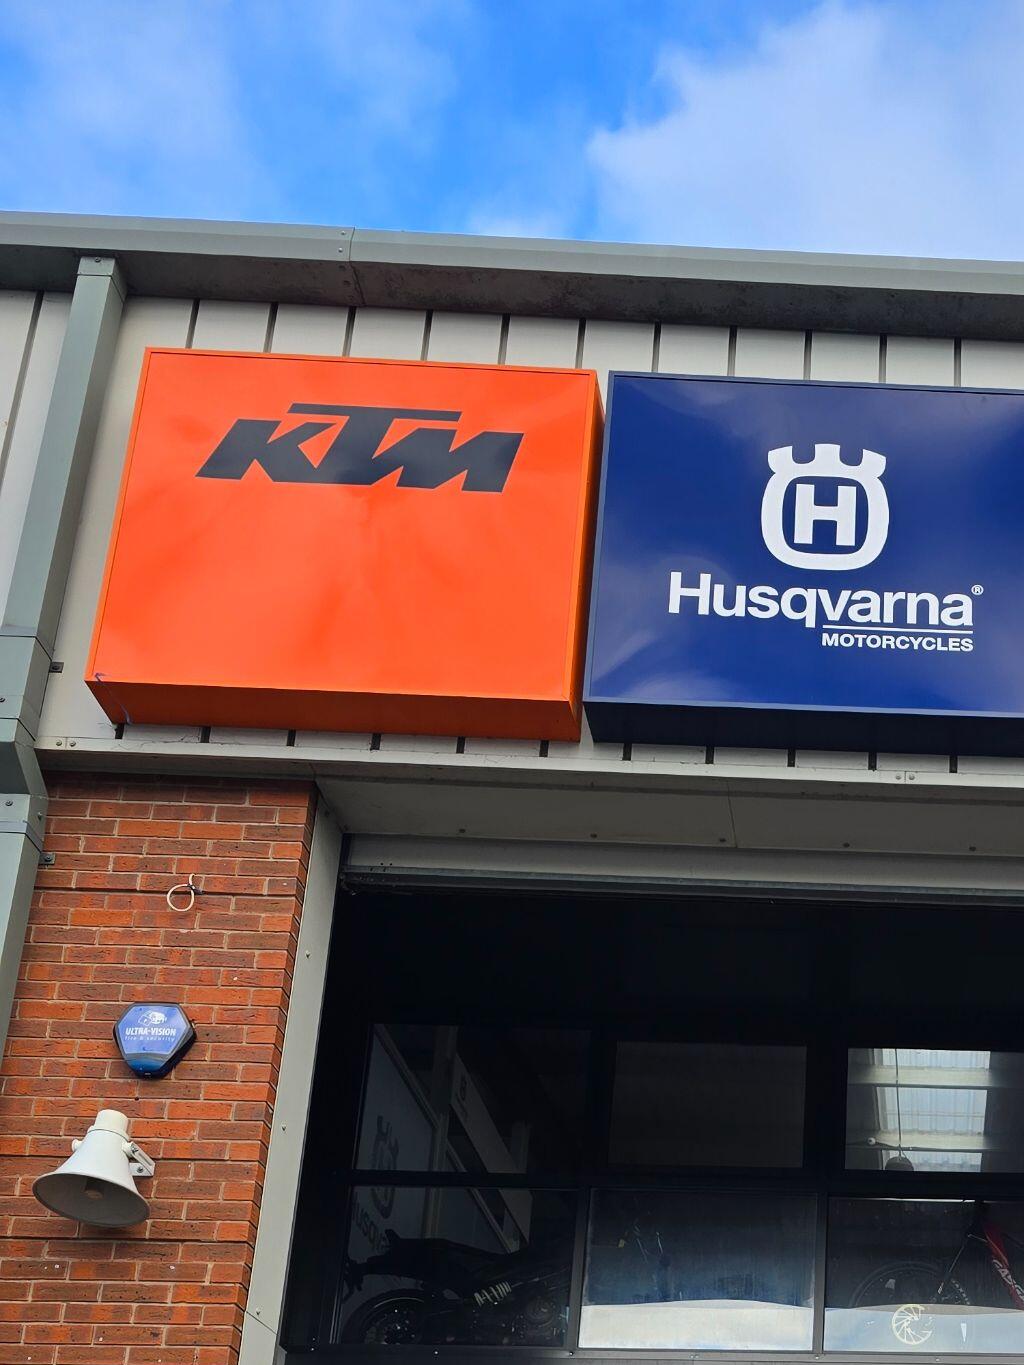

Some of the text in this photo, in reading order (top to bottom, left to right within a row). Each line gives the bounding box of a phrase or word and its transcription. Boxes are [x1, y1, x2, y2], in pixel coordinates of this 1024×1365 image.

[195, 403, 524, 493] KTM
[821, 632, 974, 652] MOTORCYCLES
[125, 1027, 176, 1036] ULTRA-VISION
